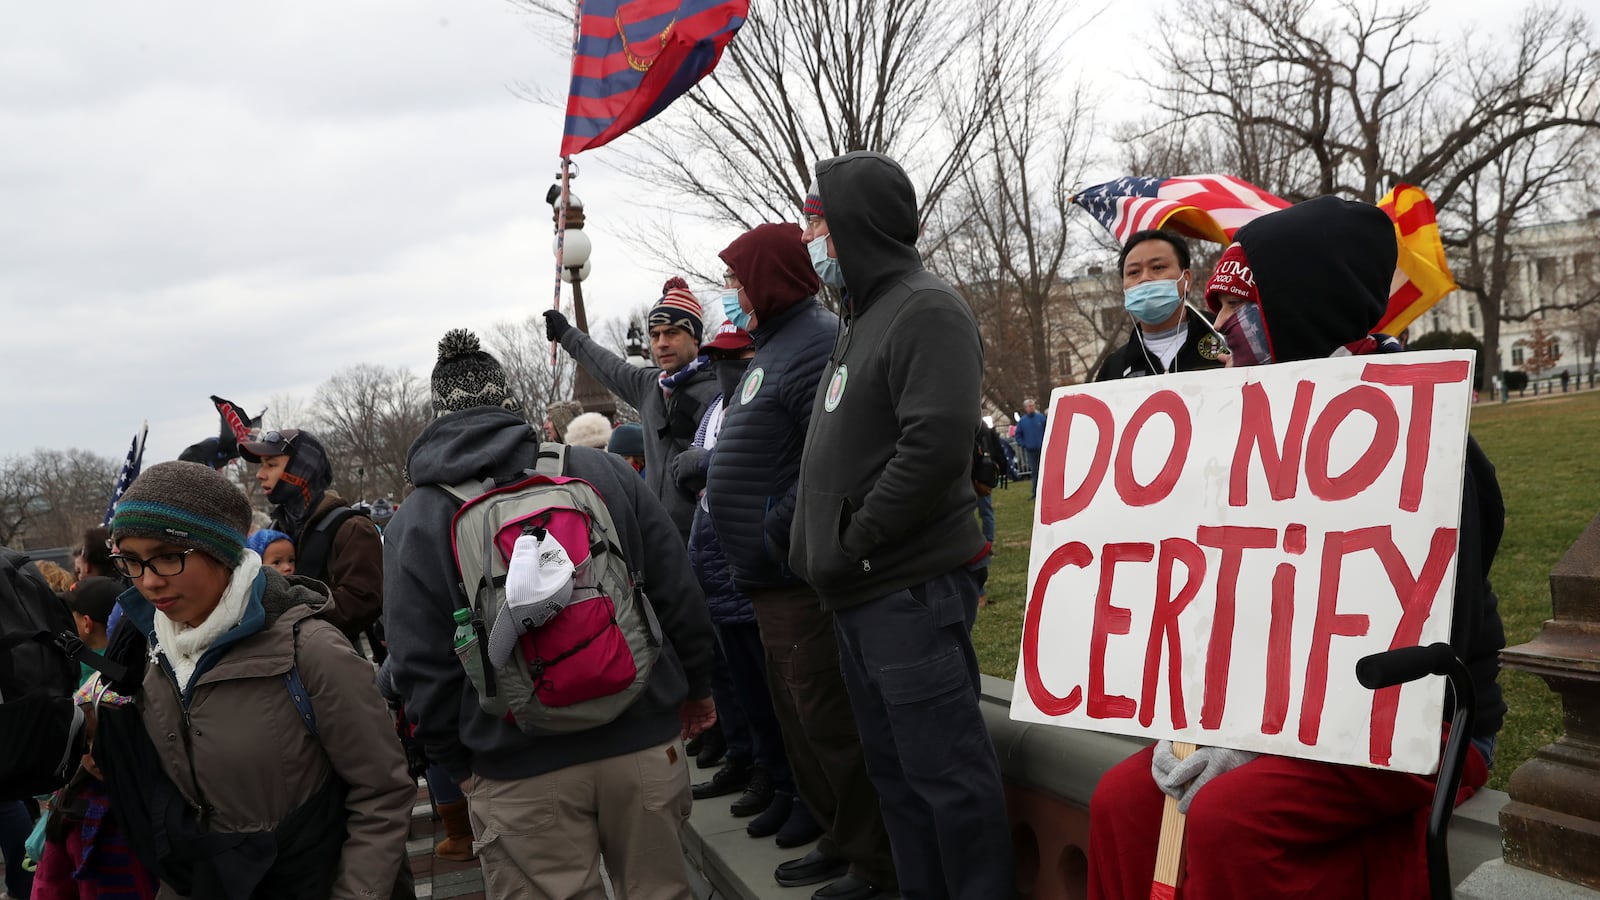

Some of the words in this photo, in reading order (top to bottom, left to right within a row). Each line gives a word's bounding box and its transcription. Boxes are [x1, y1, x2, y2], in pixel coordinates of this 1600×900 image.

[1230, 286, 1250, 298] Great
[1041, 390, 1192, 525] DO
[1229, 361, 1469, 512] NOT
